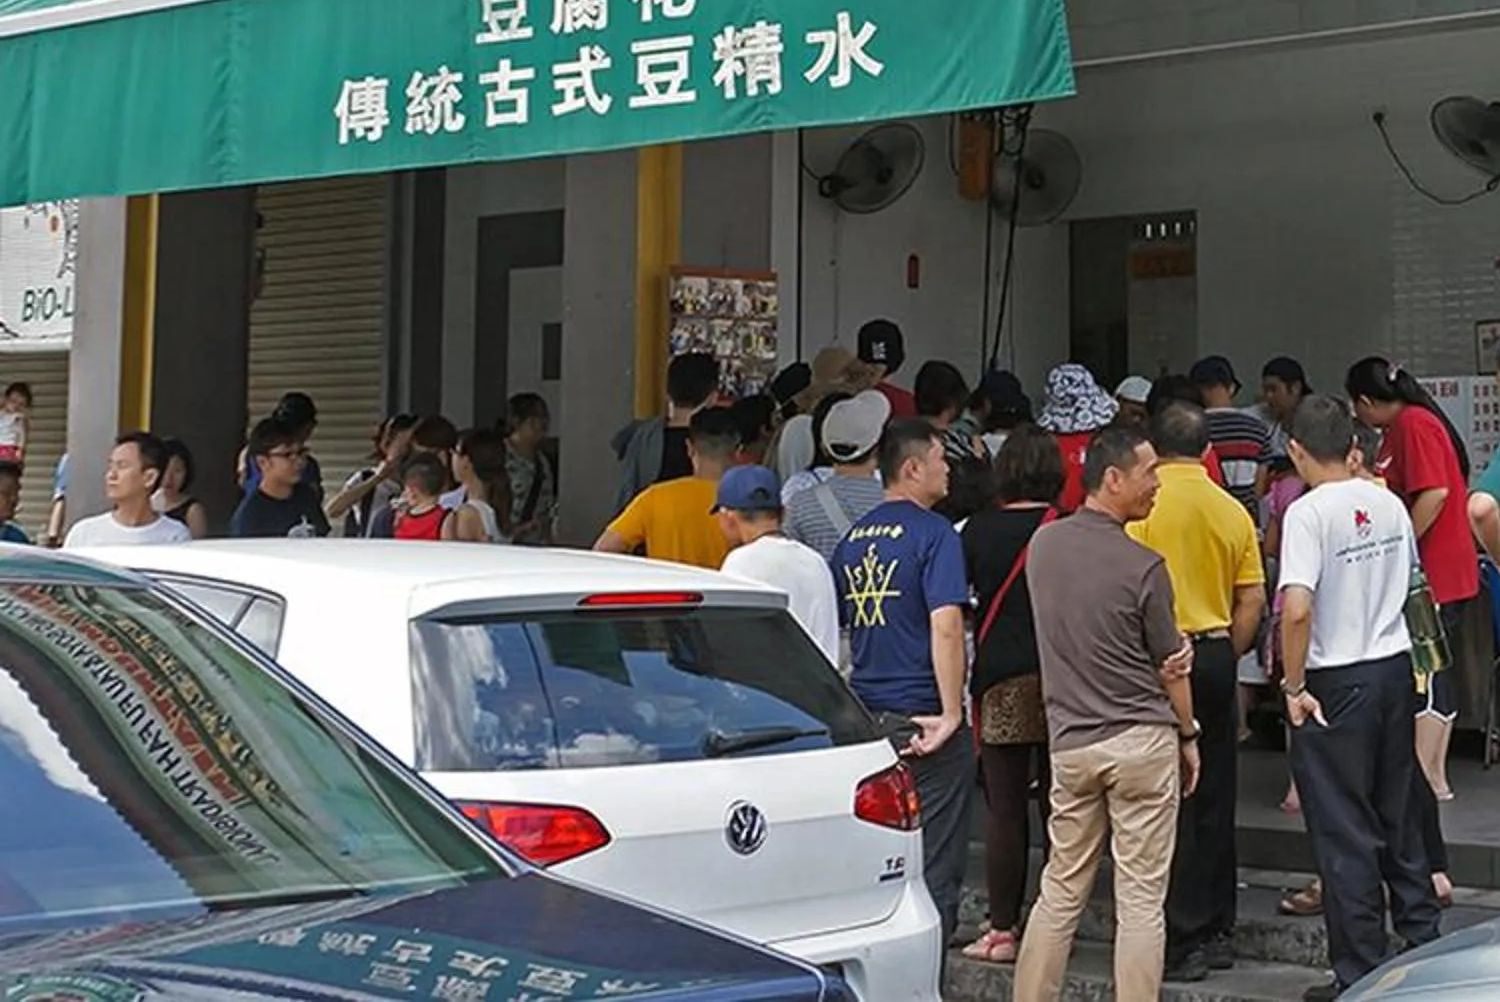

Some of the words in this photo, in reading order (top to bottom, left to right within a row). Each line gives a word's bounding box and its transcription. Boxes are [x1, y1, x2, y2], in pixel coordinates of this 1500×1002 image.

[332, 12, 885, 145] 傳統古式豆精水
